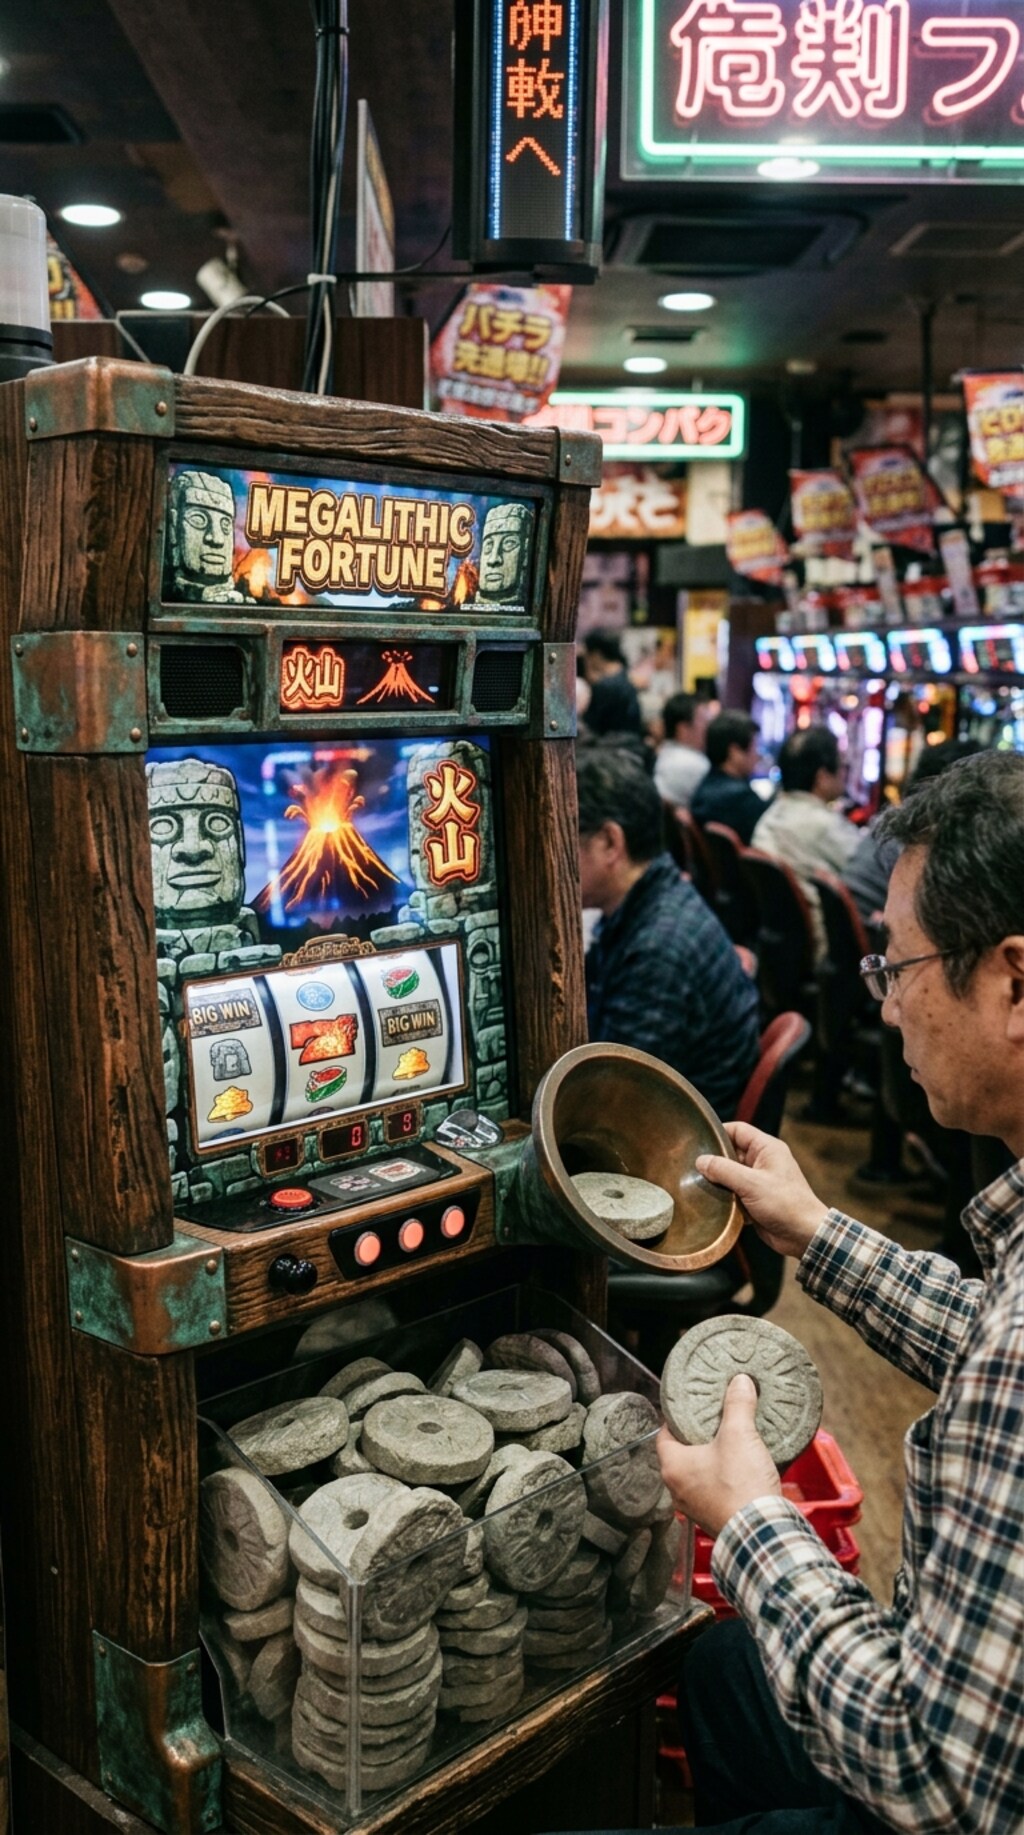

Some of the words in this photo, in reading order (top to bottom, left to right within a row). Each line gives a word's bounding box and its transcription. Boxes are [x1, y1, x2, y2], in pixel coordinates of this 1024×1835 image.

[250, 484, 474, 552] MEGALITHIC
[279, 538, 447, 592] FORTUNE
[284, 649, 342, 705] 火山
[424, 762, 478, 882] 火山
[191, 1004, 219, 1026] BIG
[218, 1000, 251, 1020] WIN
[387, 1014, 411, 1035] BIG
[410, 1010, 436, 1030] WIN
